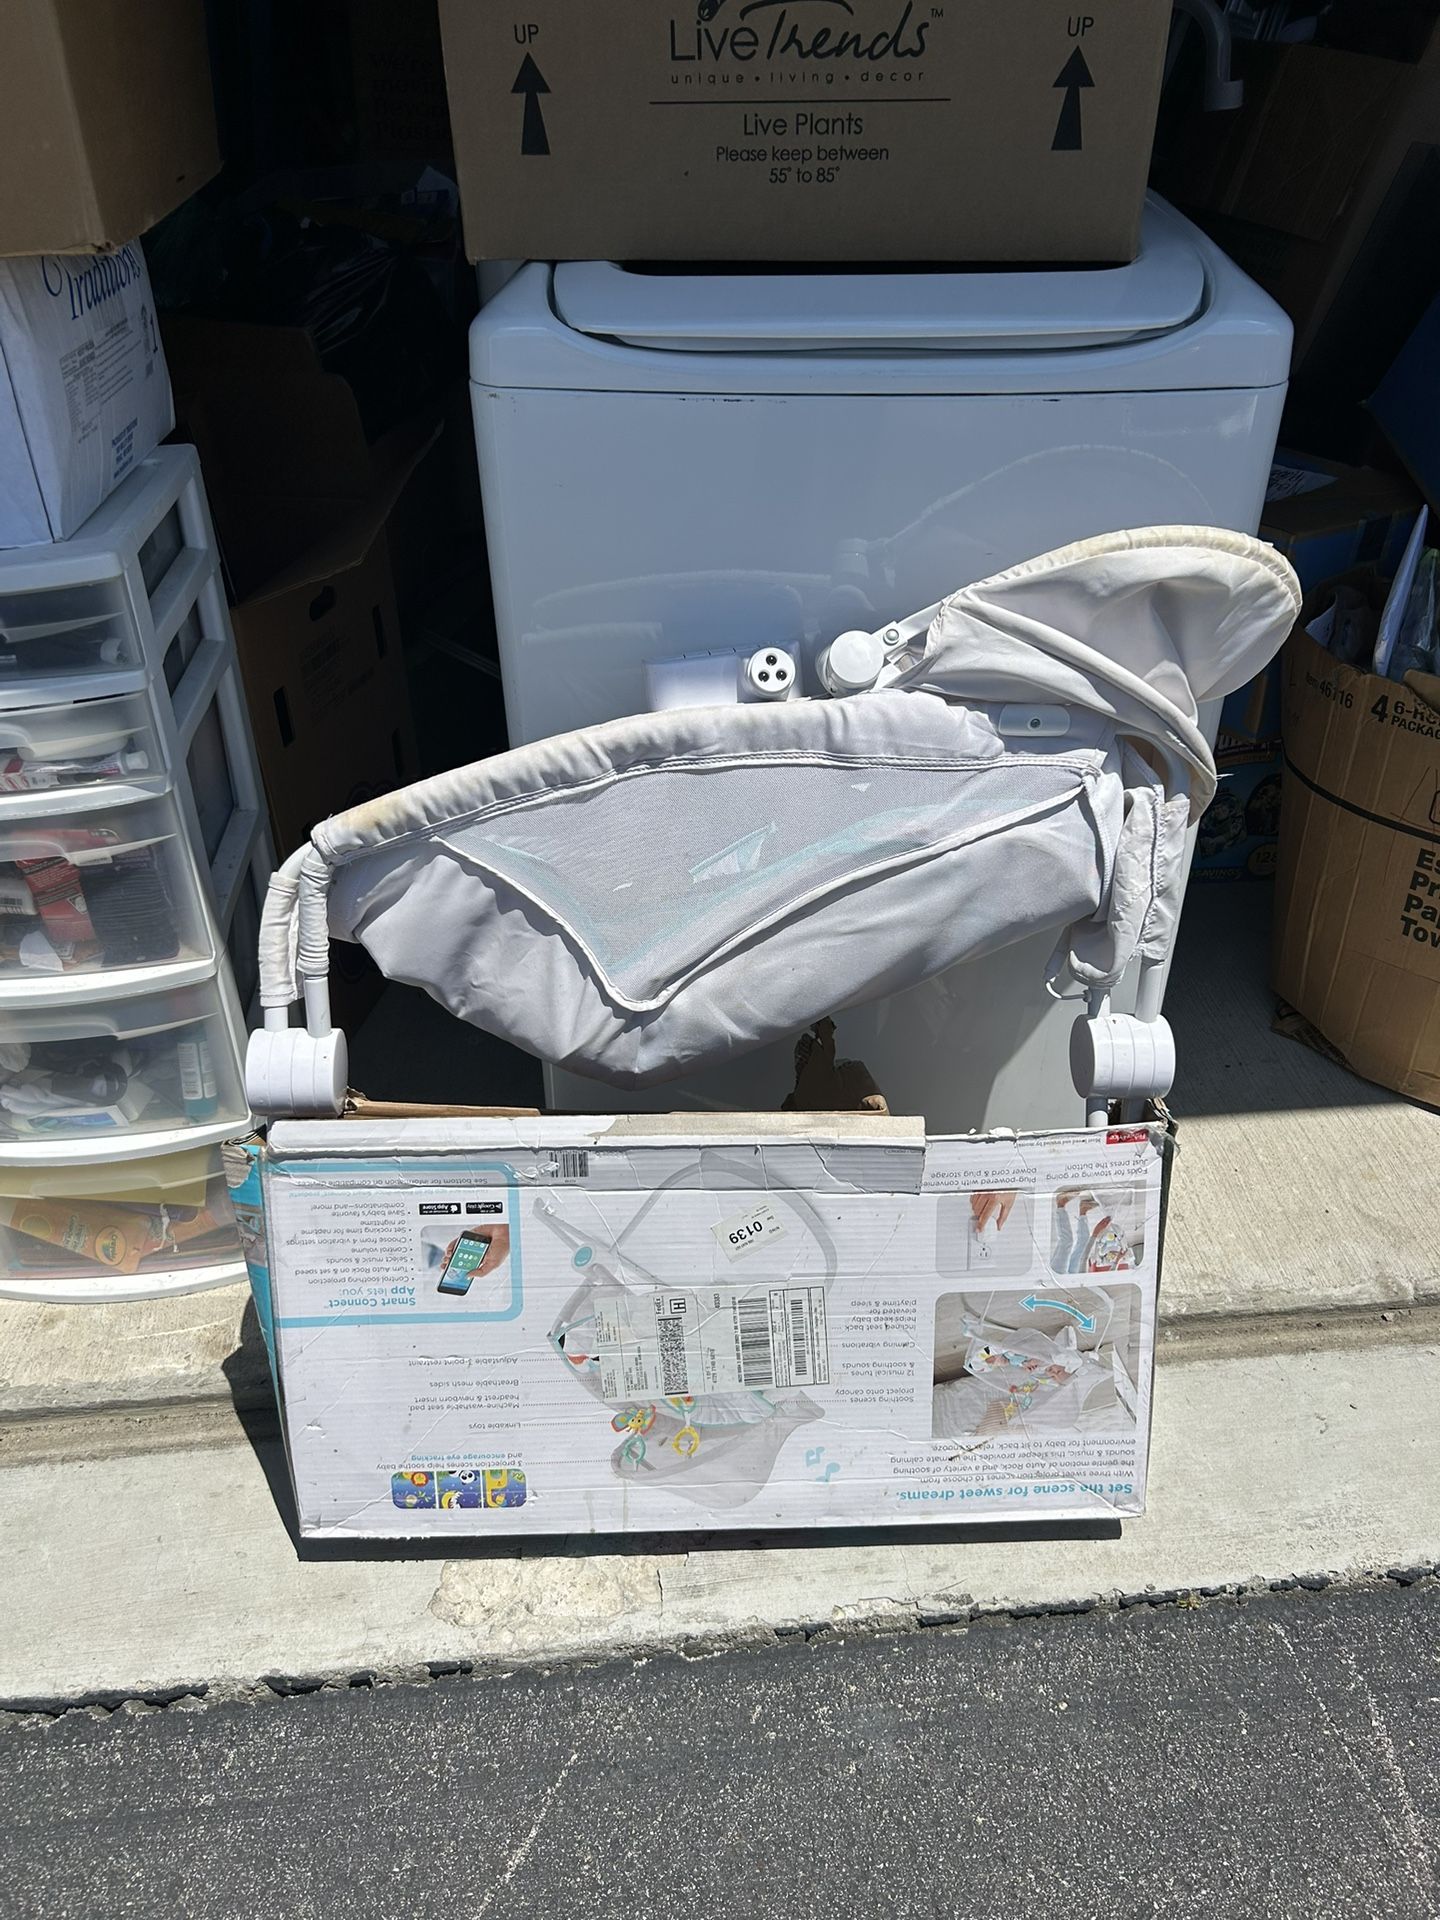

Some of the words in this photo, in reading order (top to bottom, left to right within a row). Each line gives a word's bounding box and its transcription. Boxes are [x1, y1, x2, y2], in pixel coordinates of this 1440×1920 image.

[1067, 17, 1094, 37] UP
[514, 24, 539, 44] UP
[671, 72, 745, 86] unique
[770, 71, 834, 86] living
[860, 70, 924, 82] decor
[743, 114, 787, 136] Live
[795, 112, 863, 136] Plants
[716, 146, 767, 162] Please
[771, 146, 813, 165] keep
[816, 145, 889, 162] between
[769, 167, 792, 184] 55°
[796, 169, 813, 184] to
[816, 166, 840, 184] 85°
[1319, 680, 1354, 709] 46116
[1371, 694, 1389, 723] 4
[1046, 1171, 1069, 1182] going
[1080, 1169, 1111, 1180] stowing
[1113, 1170, 1125, 1178] for
[1126, 1169, 1148, 1177] Folds
[360, 1219, 395, 1227] nighttime
[301, 1228, 331, 1236] naptime
[363, 1227, 392, 1235] rocking
[729, 1221, 763, 1244] 0139
[286, 1238, 315, 1246] settings
[295, 1268, 317, 1276] speed
[308, 1276, 346, 1285] projection
[347, 1276, 380, 1284] soothing
[339, 1287, 363, 1299] you:
[366, 1288, 387, 1298] lets
[390, 1285, 415, 1297] App
[380, 1298, 416, 1307] Smart
[673, 1302, 686, 1310] H
[851, 1300, 872, 1308] sleep
[881, 1299, 917, 1308] playtime
[852, 1316, 871, 1324] baby
[872, 1315, 893, 1324] keep
[894, 1315, 917, 1324] helps
[474, 1356, 518, 1366] Adjustable
[871, 1361, 906, 1369] soothing
[474, 1380, 519, 1388] Breathable
[886, 1387, 915, 1396] project
[484, 1395, 519, 1403] headrest
[878, 1395, 914, 1404] Soothing
[469, 1422, 485, 1431] toys
[411, 1453, 444, 1462] tracking
[978, 1452, 1015, 1461] provides
[1017, 1451, 1048, 1460] sleeper
[1105, 1450, 1136, 1458] sounds
[474, 1459, 515, 1469] projection
[890, 1455, 923, 1464] calming
[1090, 1459, 1118, 1468] gentle
[376, 1462, 396, 1471] baby
[426, 1461, 444, 1470] help
[893, 1465, 930, 1475] soothing
[942, 1464, 972, 1473] variety
[942, 1476, 973, 1484] choose
[1015, 1472, 1060, 1481] projection
[959, 1488, 1002, 1500] sweet
[1007, 1488, 1028, 1498] for
[1033, 1486, 1075, 1495] scene
[1108, 1484, 1133, 1496] Set
[896, 1490, 954, 1502] dreams.
